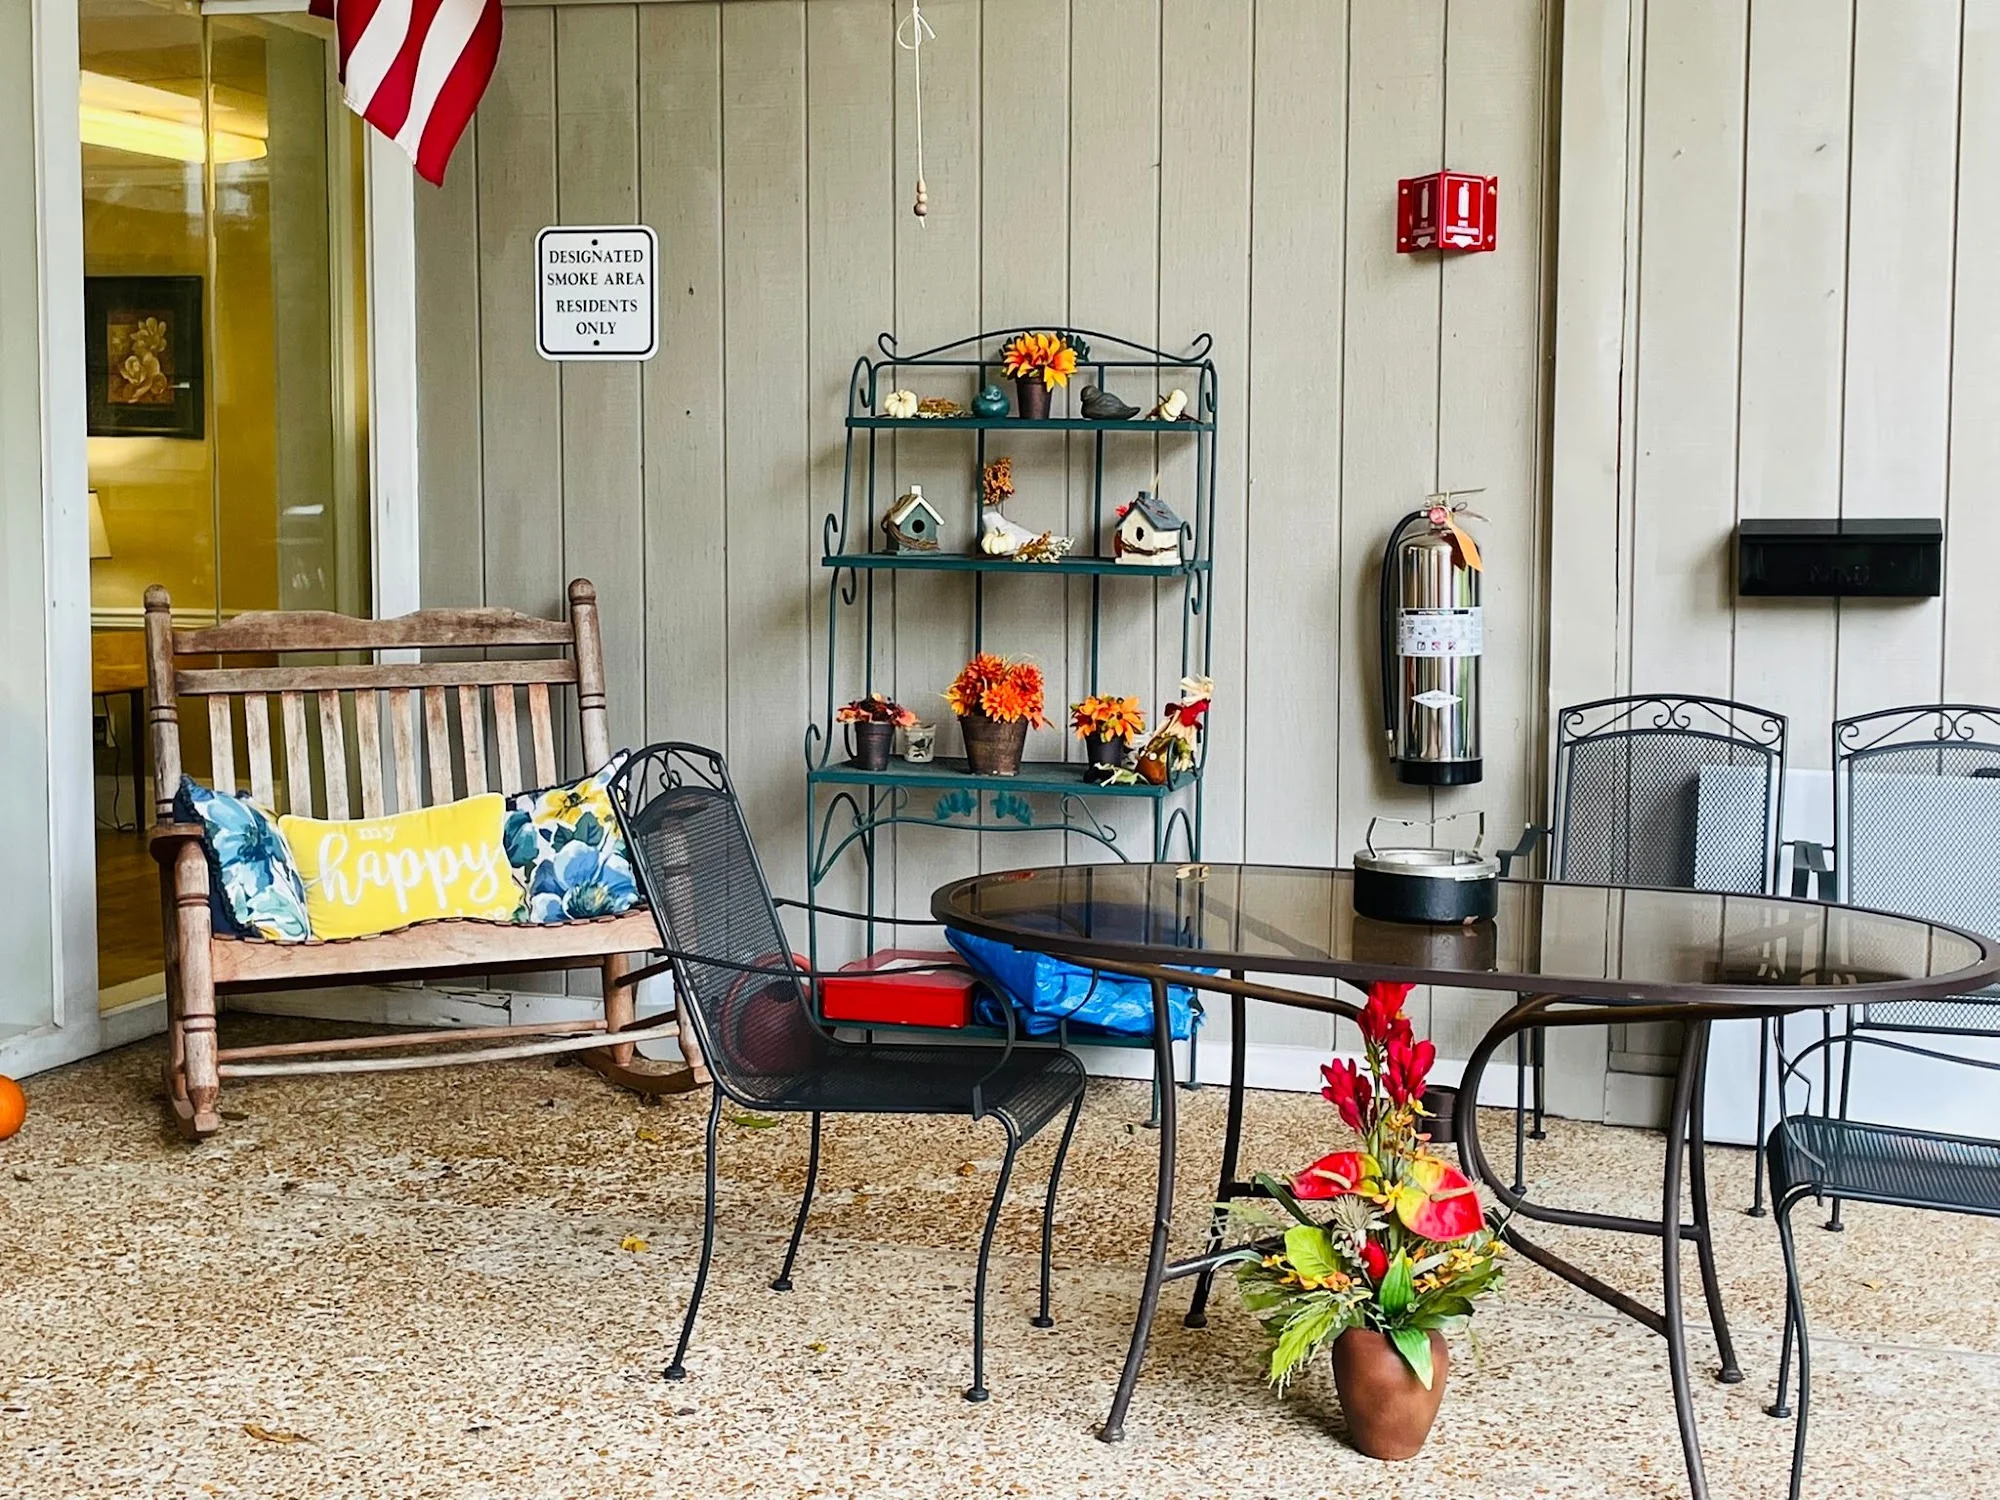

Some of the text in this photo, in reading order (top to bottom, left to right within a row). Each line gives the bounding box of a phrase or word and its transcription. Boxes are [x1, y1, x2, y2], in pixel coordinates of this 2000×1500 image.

[549, 249, 644, 264] DESIGNATED
[547, 272, 646, 286] SMOKE AREA
[556, 299, 638, 313] RESIDENTS
[576, 321, 616, 335] ONLY
[357, 826, 396, 842] my
[310, 832, 501, 913] happy
